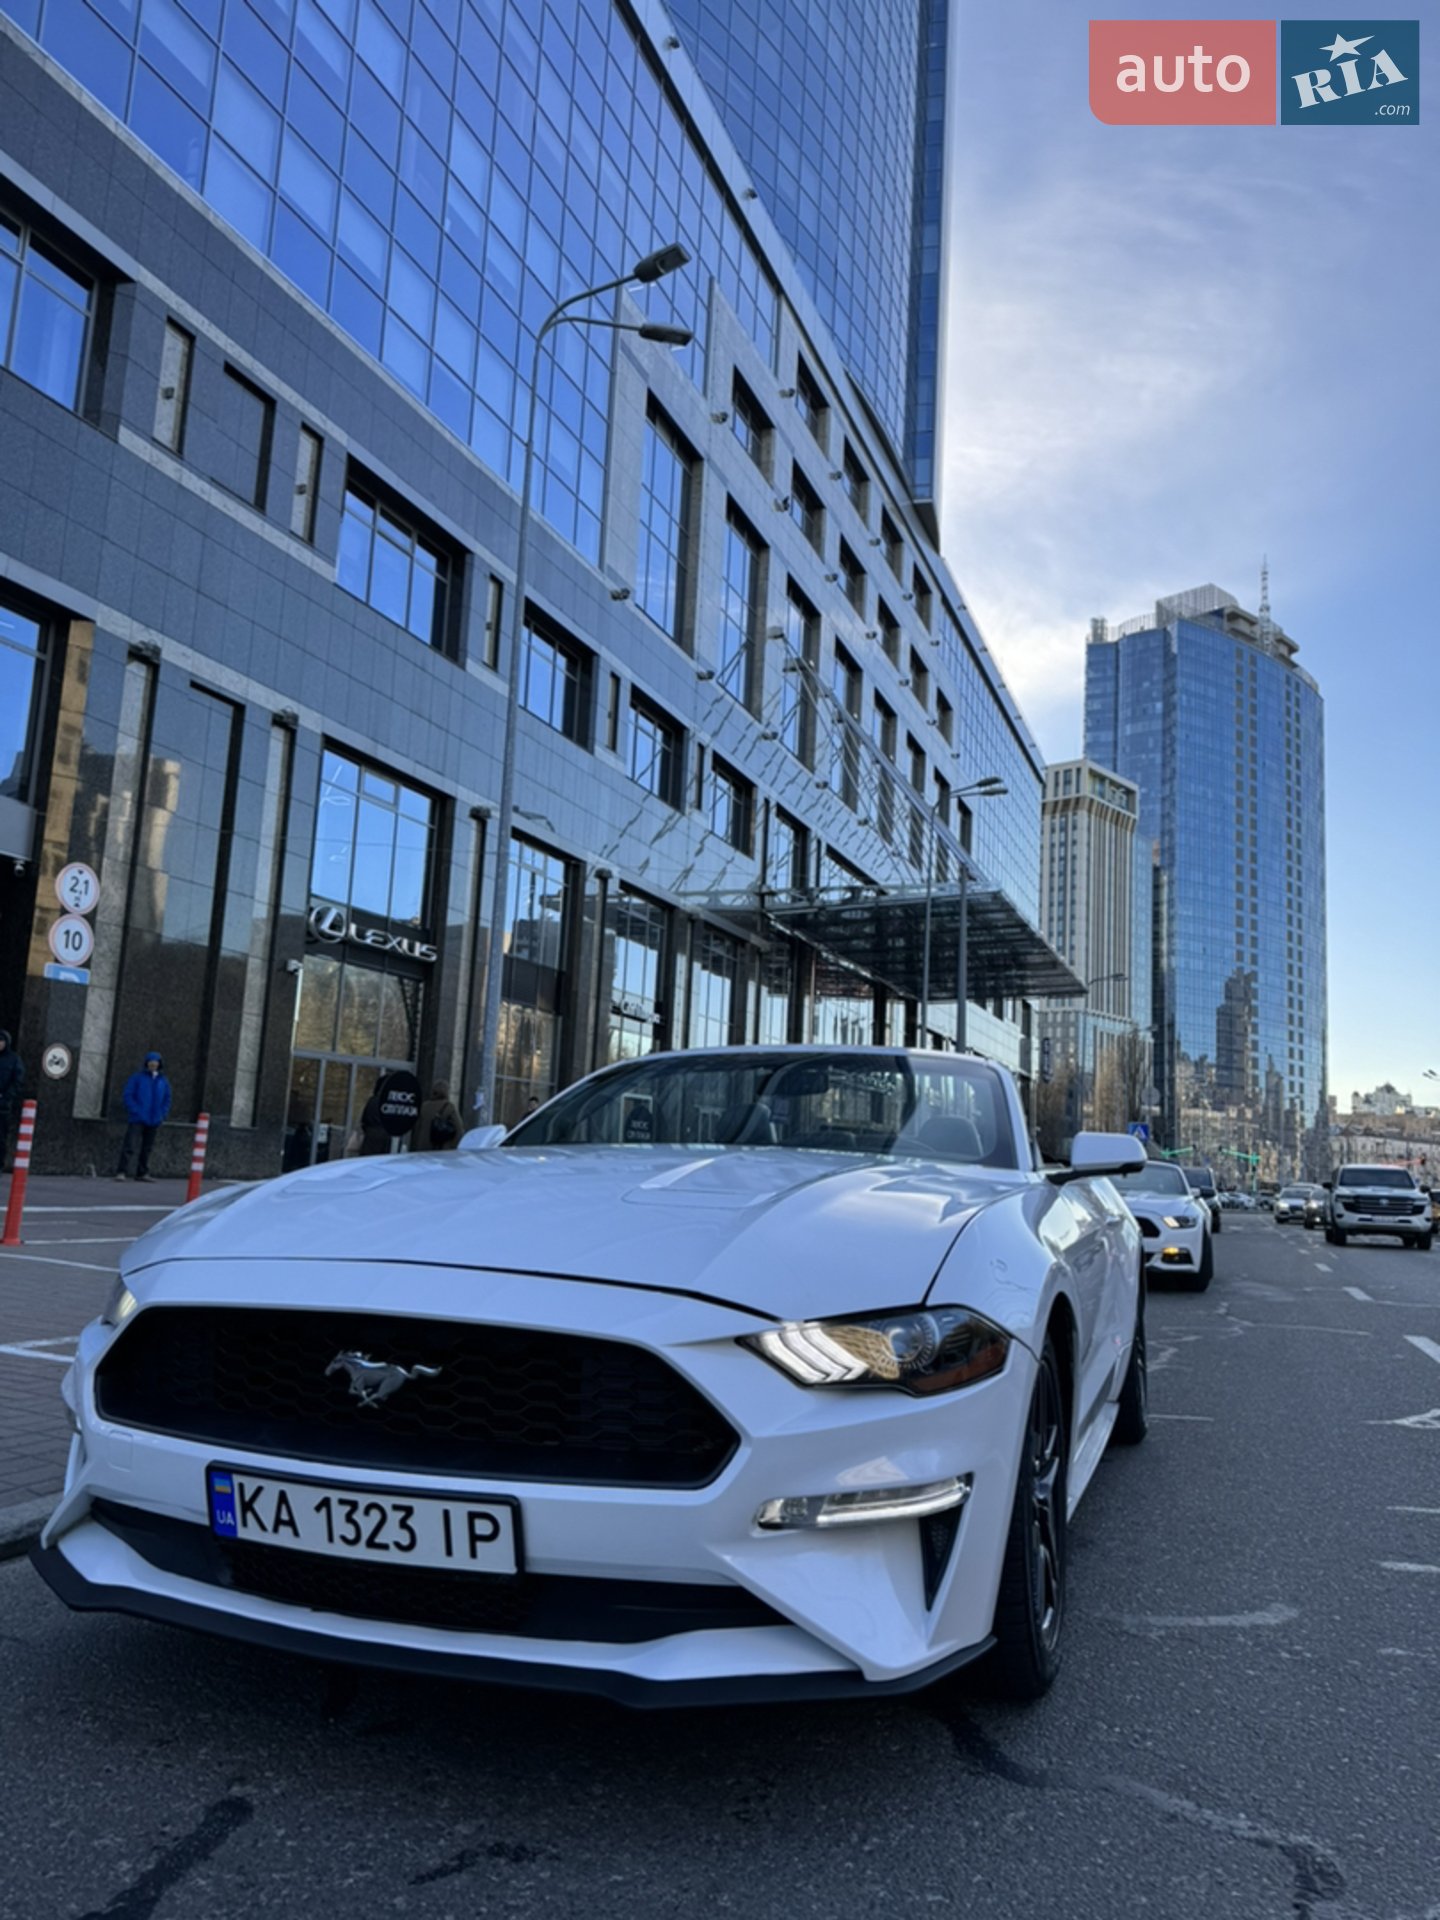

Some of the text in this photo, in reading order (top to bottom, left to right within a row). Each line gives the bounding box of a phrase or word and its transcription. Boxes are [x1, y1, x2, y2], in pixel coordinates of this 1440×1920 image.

[69, 876, 90, 896] 2,1
[64, 929, 83, 951] 10
[348, 922, 438, 962] LEXUS
[216, 1509, 235, 1526] UA
[238, 1481, 501, 1559] KA 1323 IP
